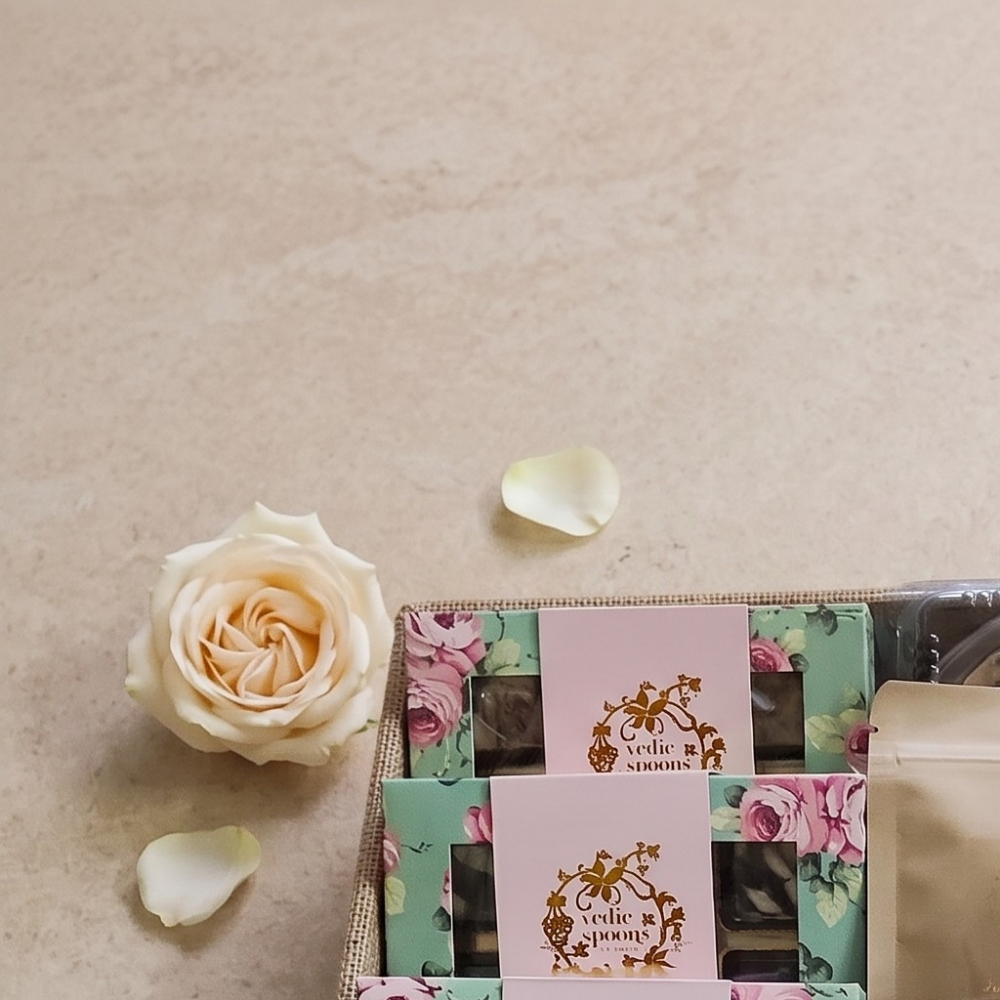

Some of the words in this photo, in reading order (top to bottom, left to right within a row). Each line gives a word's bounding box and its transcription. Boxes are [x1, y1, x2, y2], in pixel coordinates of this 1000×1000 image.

[626, 738, 676, 756] vedic
[626, 758, 690, 772] spoons
[581, 907, 633, 925] vedic
[581, 927, 650, 948] spoons
